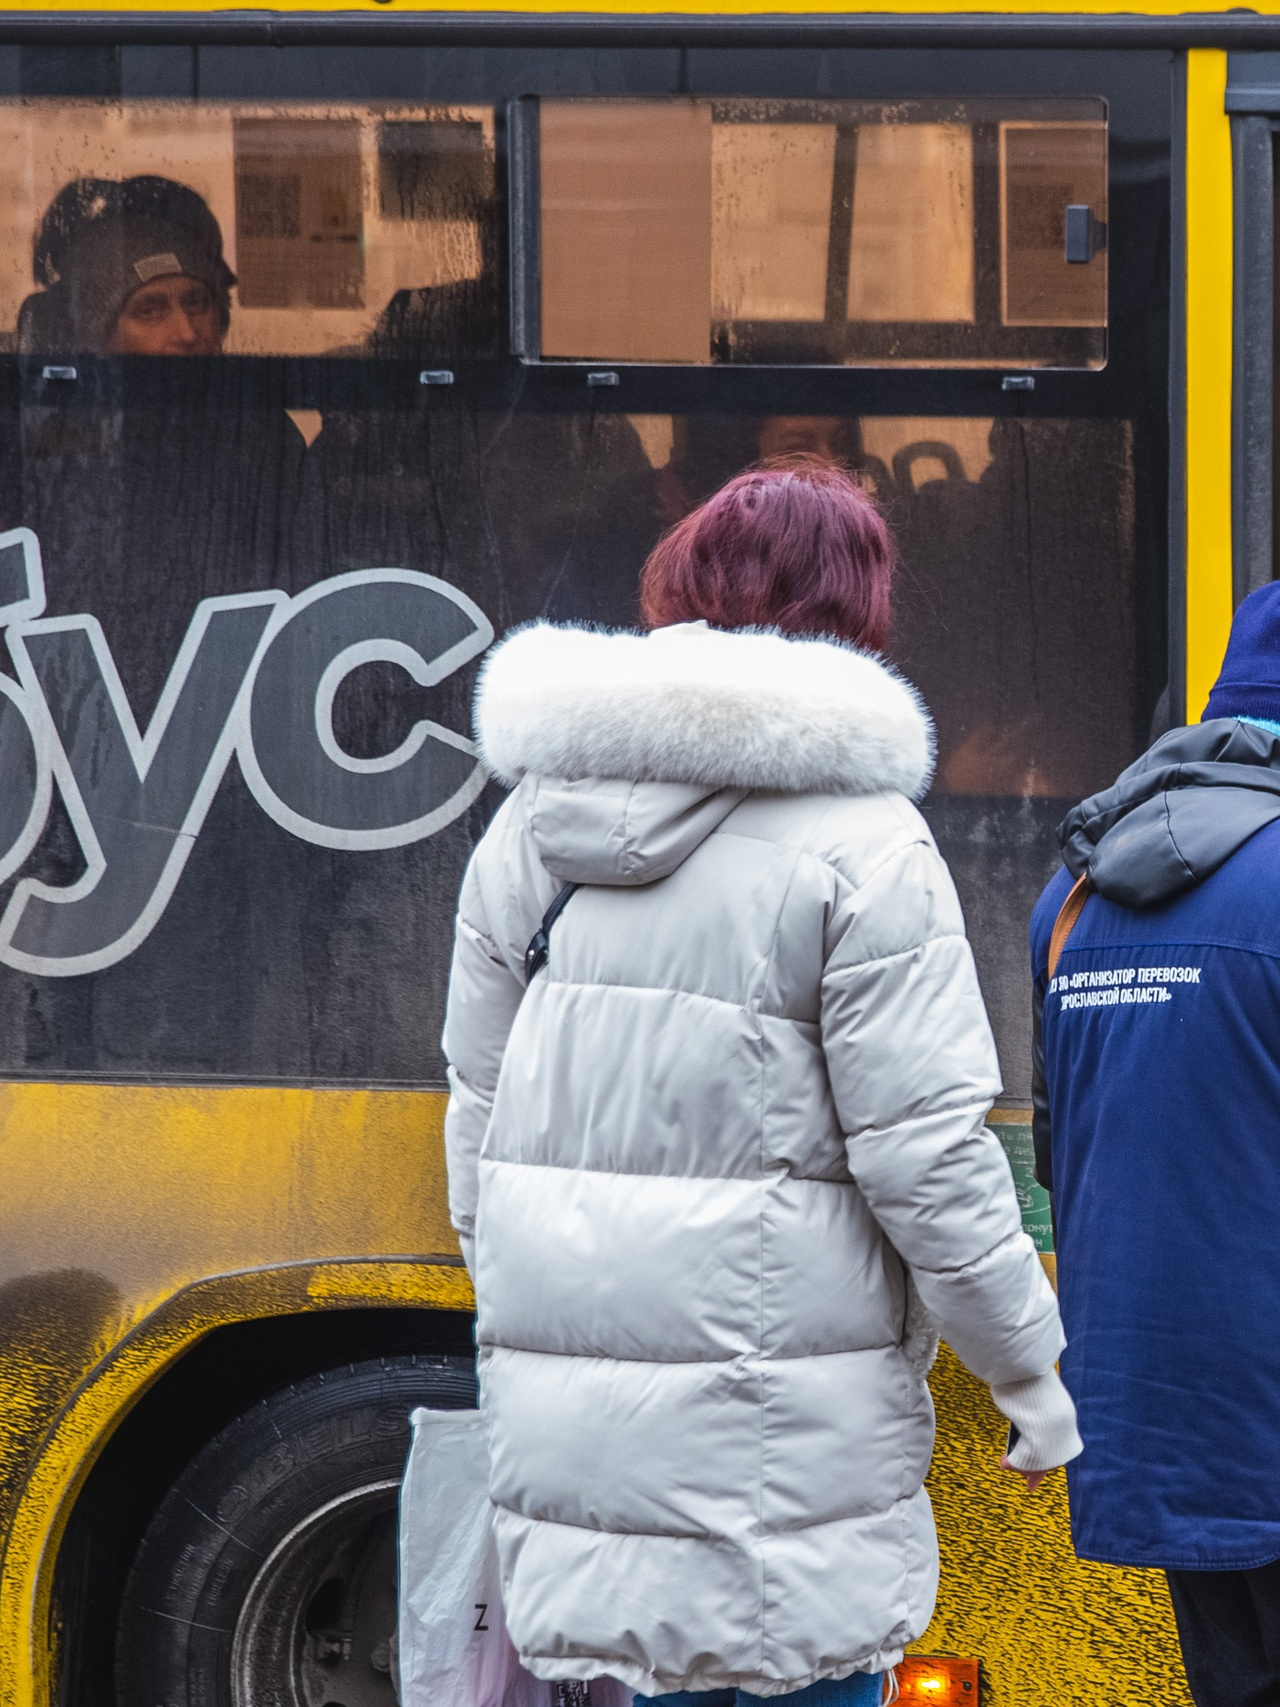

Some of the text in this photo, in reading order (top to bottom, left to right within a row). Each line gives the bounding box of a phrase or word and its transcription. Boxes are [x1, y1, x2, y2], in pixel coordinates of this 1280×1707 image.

[0, 526, 495, 978] ус
[1060, 987, 1172, 1011] ЯРОСЛАВСКОЙ ОБЛАСТИ»
[1069, 968, 1136, 988] «ОРГАНИЗАТОР
[1137, 967, 1201, 983] ПЕРЕВОЗОК
[256, 1405, 411, 1490] BELS
